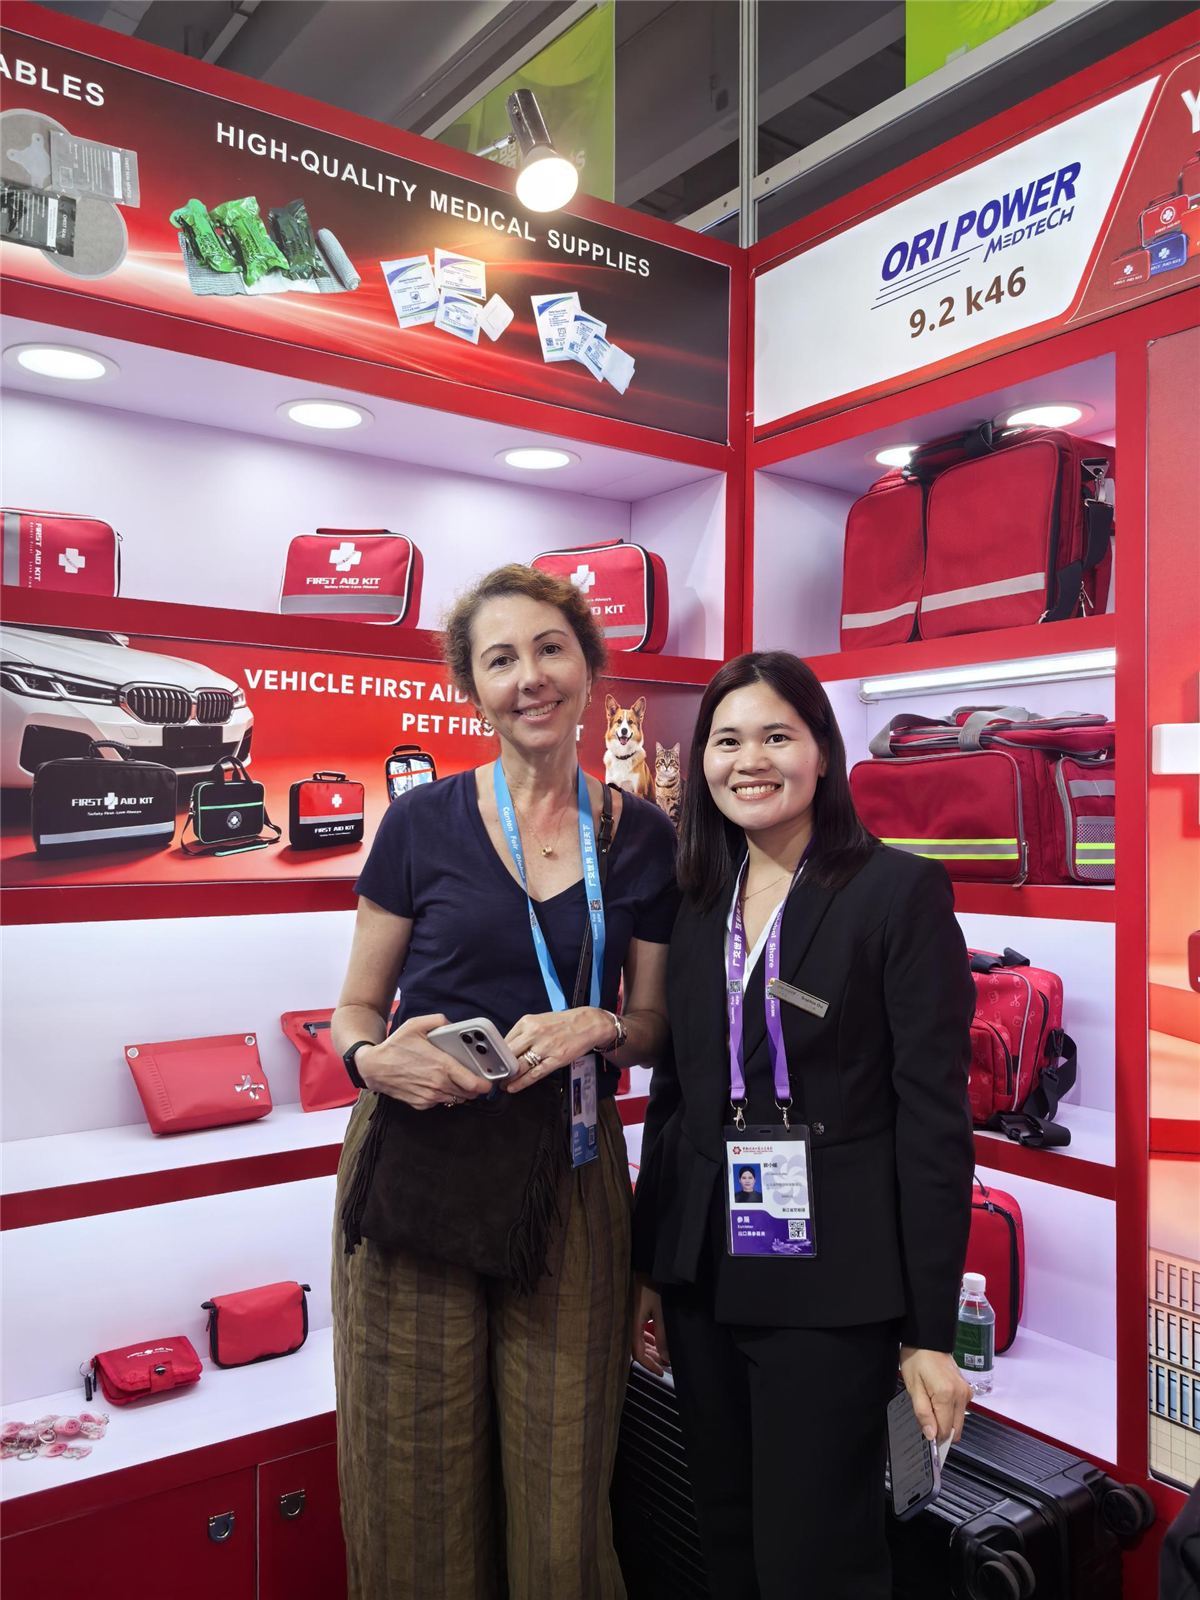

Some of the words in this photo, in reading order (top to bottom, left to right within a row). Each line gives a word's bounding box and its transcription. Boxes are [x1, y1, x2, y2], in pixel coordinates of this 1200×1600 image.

[216, 121, 418, 203] HIGH-QUALITY
[430, 190, 536, 242] MEDICAL
[547, 229, 651, 278] SUPPLIES
[881, 221, 948, 281] ORI
[951, 161, 1081, 253] POWER
[983, 205, 1074, 263] MEDTECH
[909, 296, 955, 339] 9.2
[965, 266, 1026, 316] k46
[34, 549, 42, 565] AID
[34, 565, 42, 581] KIT
[306, 577, 337, 585] FIRST
[339, 577, 360, 585] AID
[362, 577, 381, 585] KIT
[604, 604, 625, 615] KIT
[245, 668, 355, 695] VEHICLE
[360, 676, 426, 701] FIRST
[402, 712, 444, 733] PET
[448, 716, 495, 737] FIRS
[71, 798, 103, 807] FIRST
[120, 796, 137, 805] AID
[139, 796, 154, 805] KIT
[314, 826, 332, 834] FIRST
[502, 806, 514, 832] Canton
[509, 835, 519, 850] Fair
[732, 933, 743, 967] 广交世界
